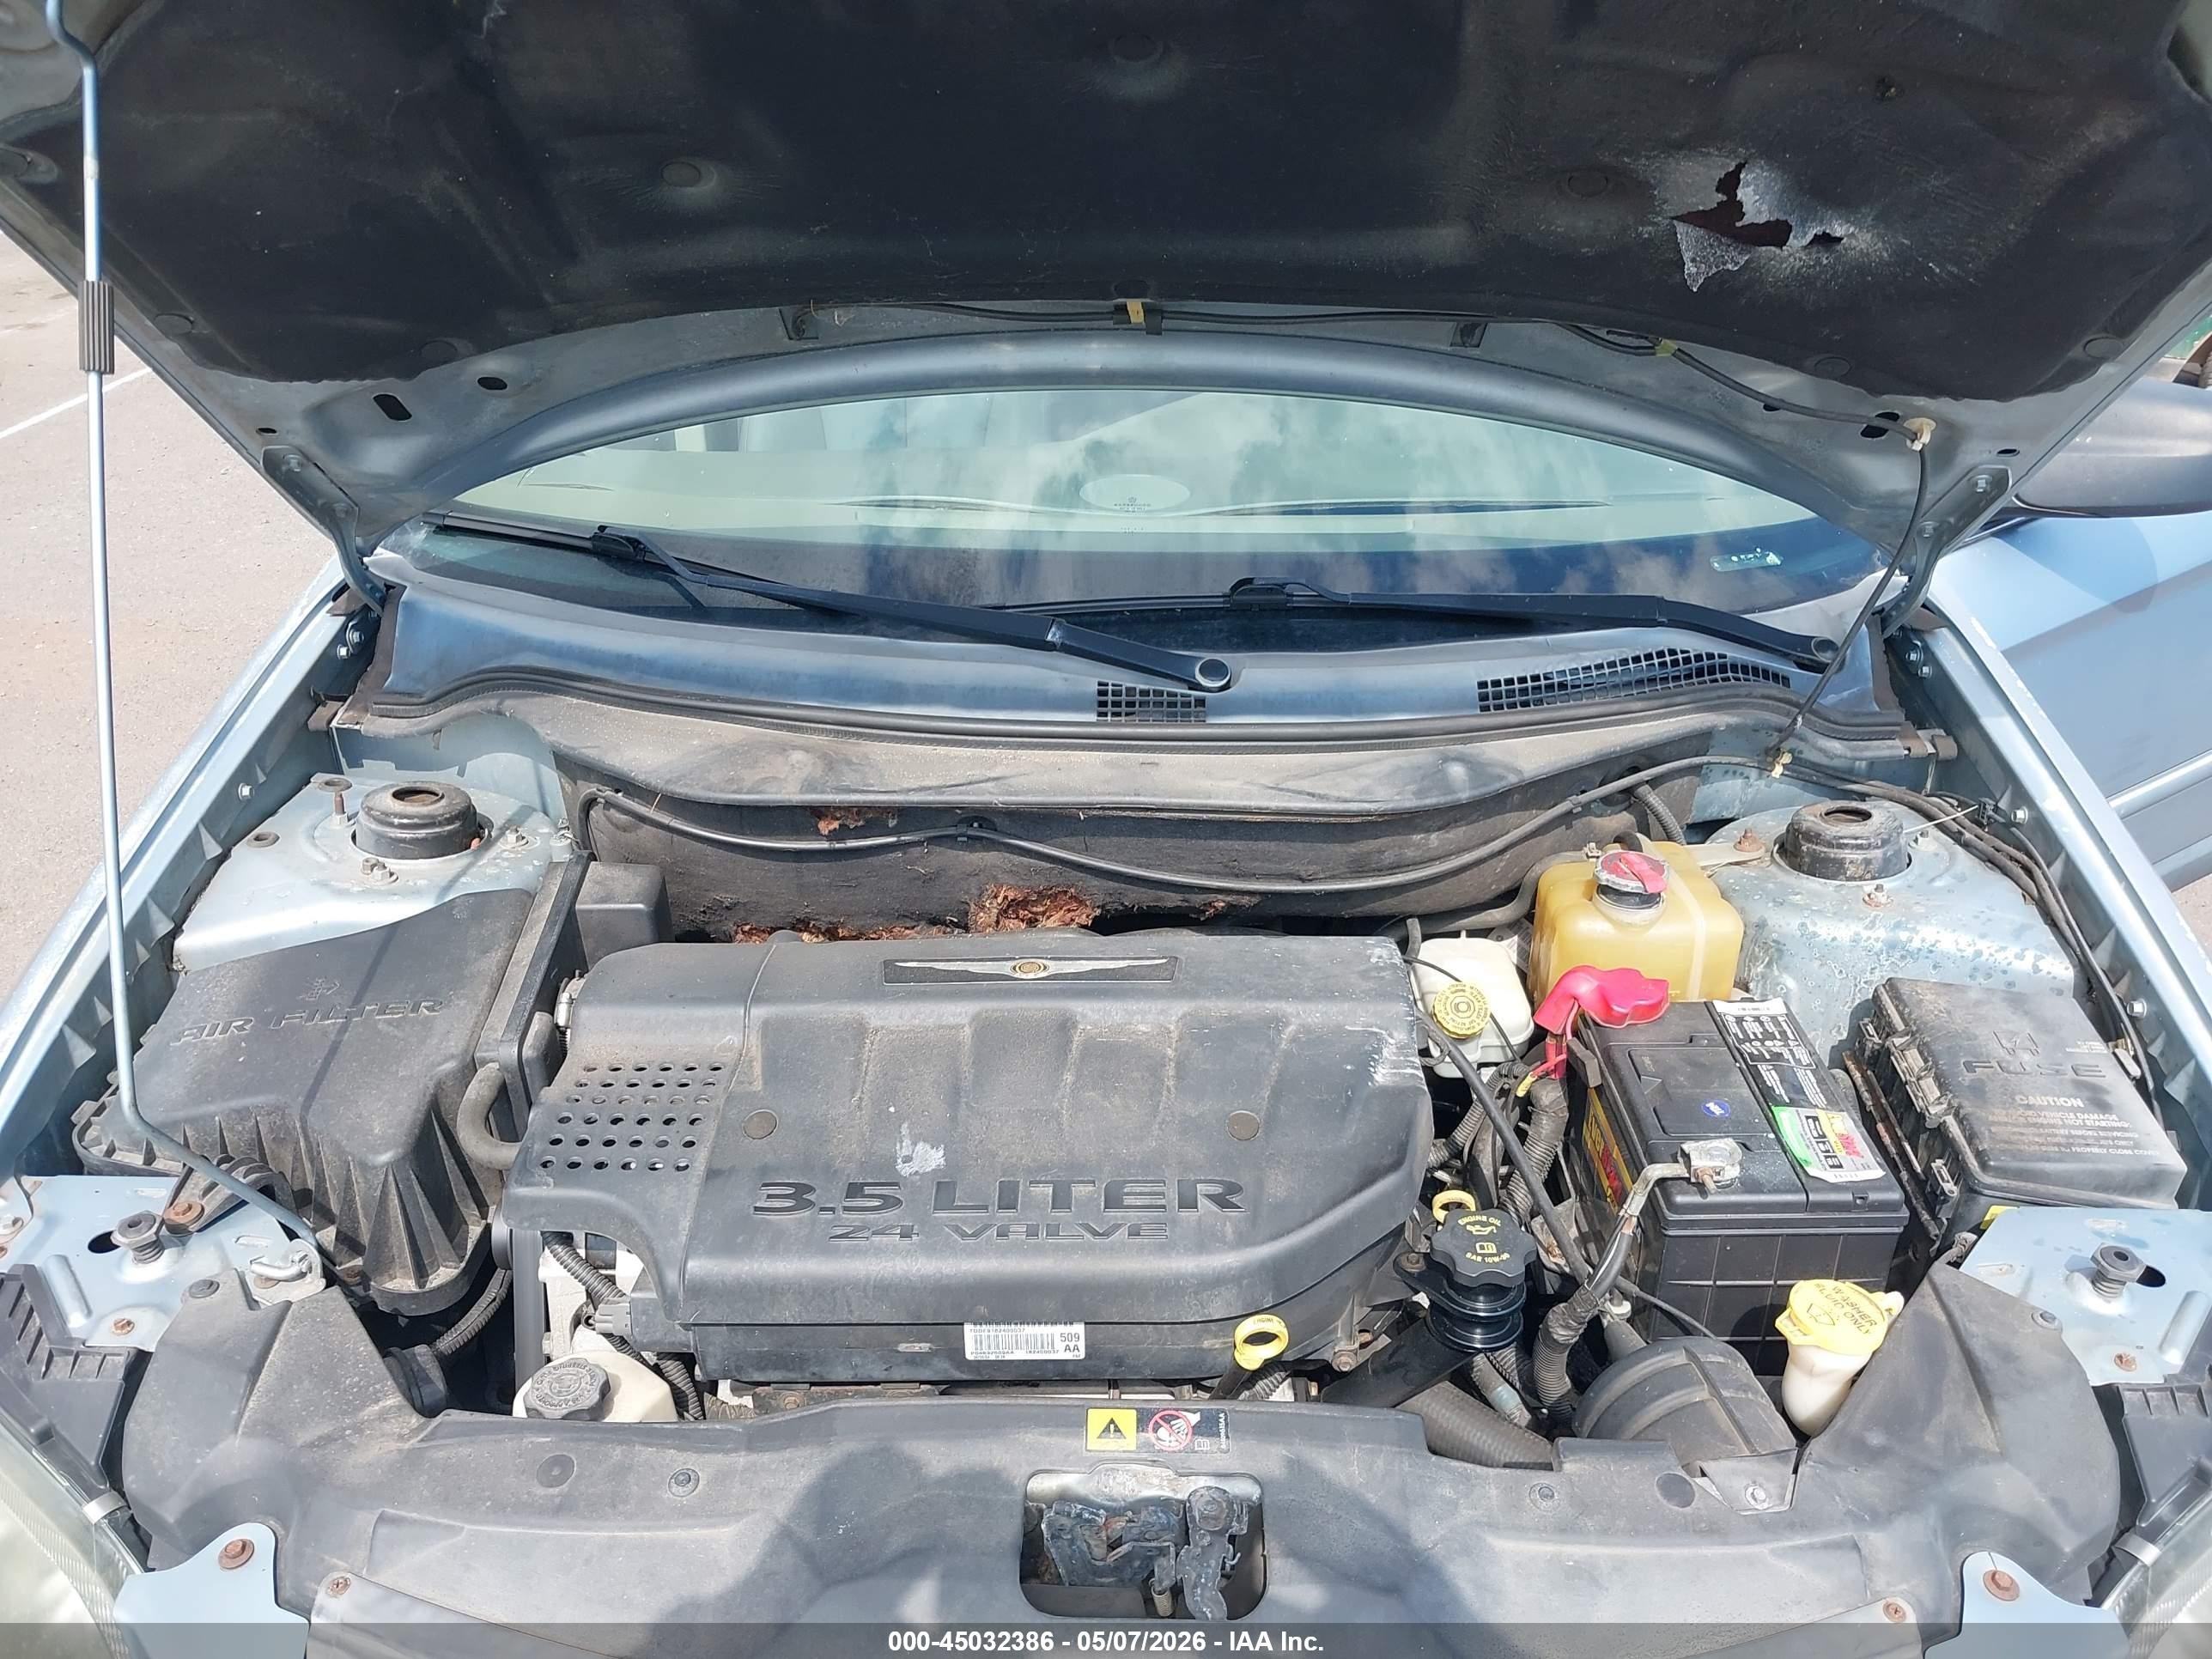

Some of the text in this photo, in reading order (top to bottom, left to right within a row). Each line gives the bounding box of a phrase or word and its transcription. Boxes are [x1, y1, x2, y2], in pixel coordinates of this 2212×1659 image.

[170, 999, 445, 1047] AIR FILTER
[1962, 1060, 2106, 1079] FUSE
[2014, 1094, 2085, 1108] CAUTION
[2076, 1113, 2119, 1121] DAMAGE
[752, 1177, 1249, 1217] 3.5 LITER
[1457, 1215, 1502, 1227] ENGINE OIL
[829, 1221, 1169, 1243] 24 VALVE
[1465, 1251, 1482, 1263] SAE
[1814, 1283, 1872, 1334] FLUID ONLY
[1832, 1285, 1878, 1327] WASHER
[1060, 1332, 1080, 1342] 509
[1063, 1344, 1080, 1353] AA
